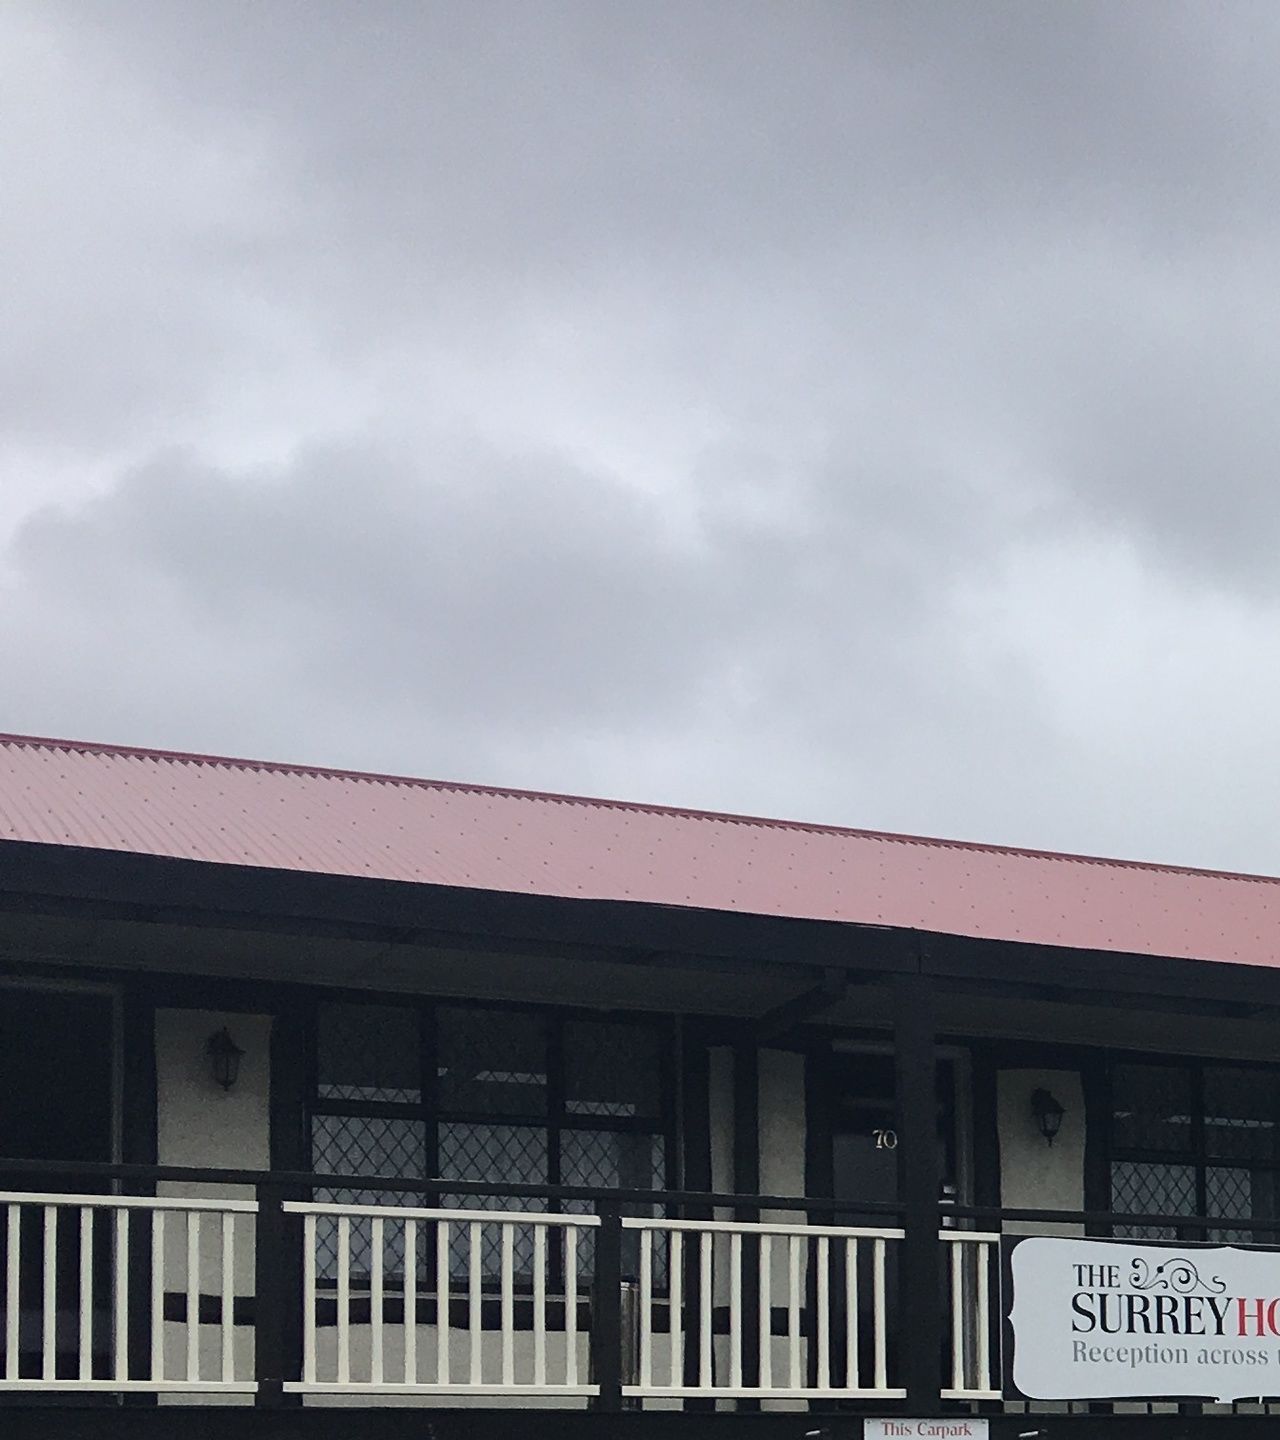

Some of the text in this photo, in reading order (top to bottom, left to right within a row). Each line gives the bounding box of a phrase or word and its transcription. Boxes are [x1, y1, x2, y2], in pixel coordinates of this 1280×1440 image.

[1072, 1263, 1121, 1288] THE
[1071, 1291, 1233, 1335] SURREY
[1072, 1340, 1188, 1368] Reception
[1197, 1348, 1269, 1365] across
[881, 1421, 972, 1439] This Carpark
